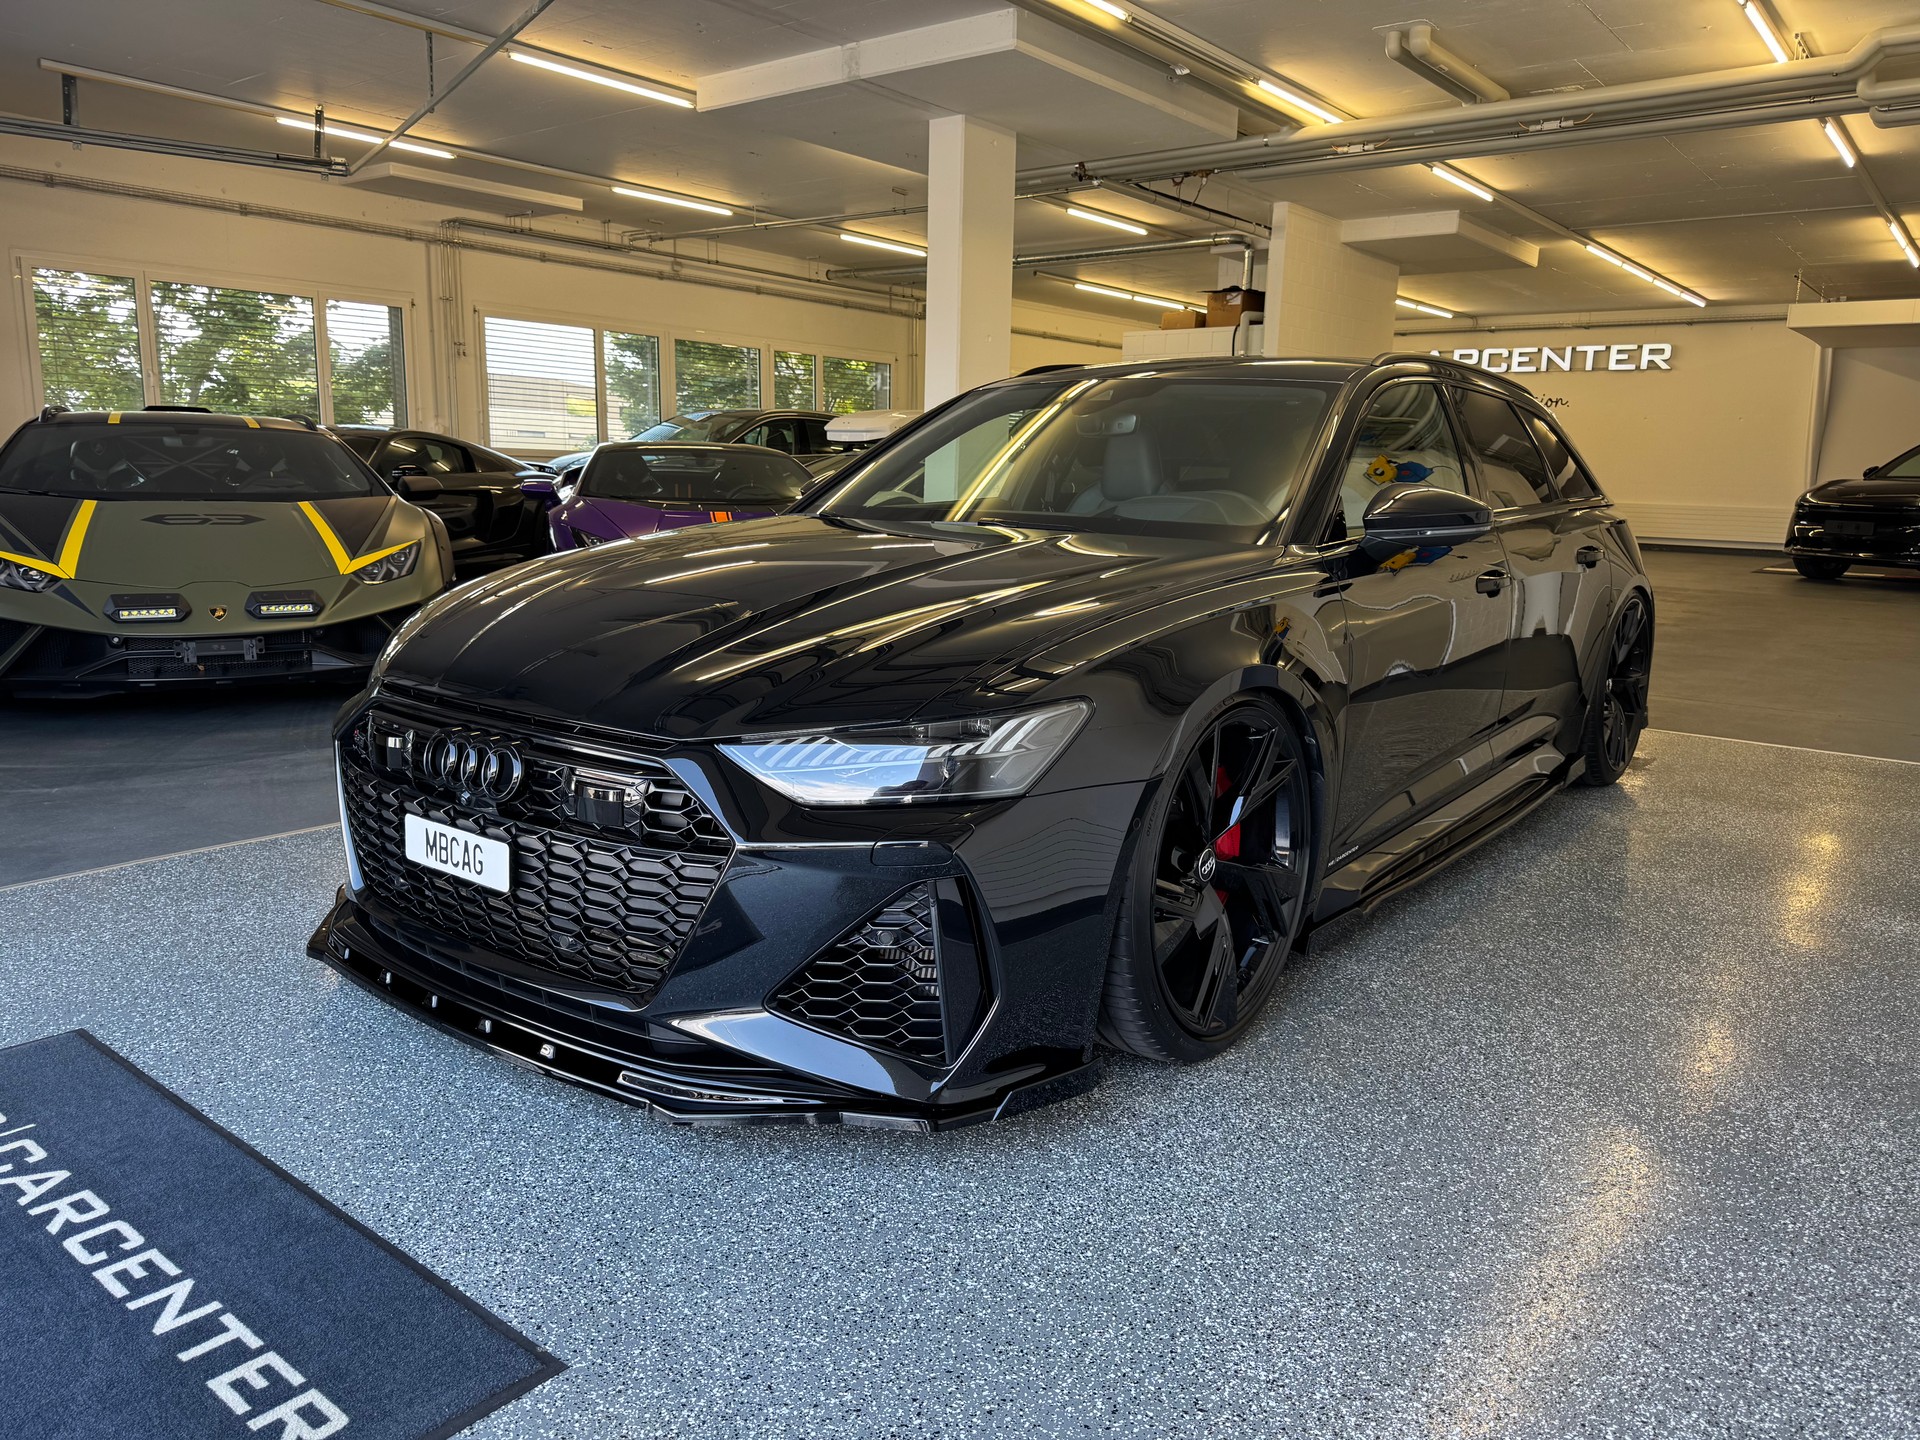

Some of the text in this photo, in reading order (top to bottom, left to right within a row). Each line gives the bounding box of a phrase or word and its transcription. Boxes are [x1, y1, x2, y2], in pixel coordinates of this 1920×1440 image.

[1429, 343, 1672, 373] RCENTER
[1535, 393, 1570, 408] ion.
[425, 827, 484, 876] MBCAG
